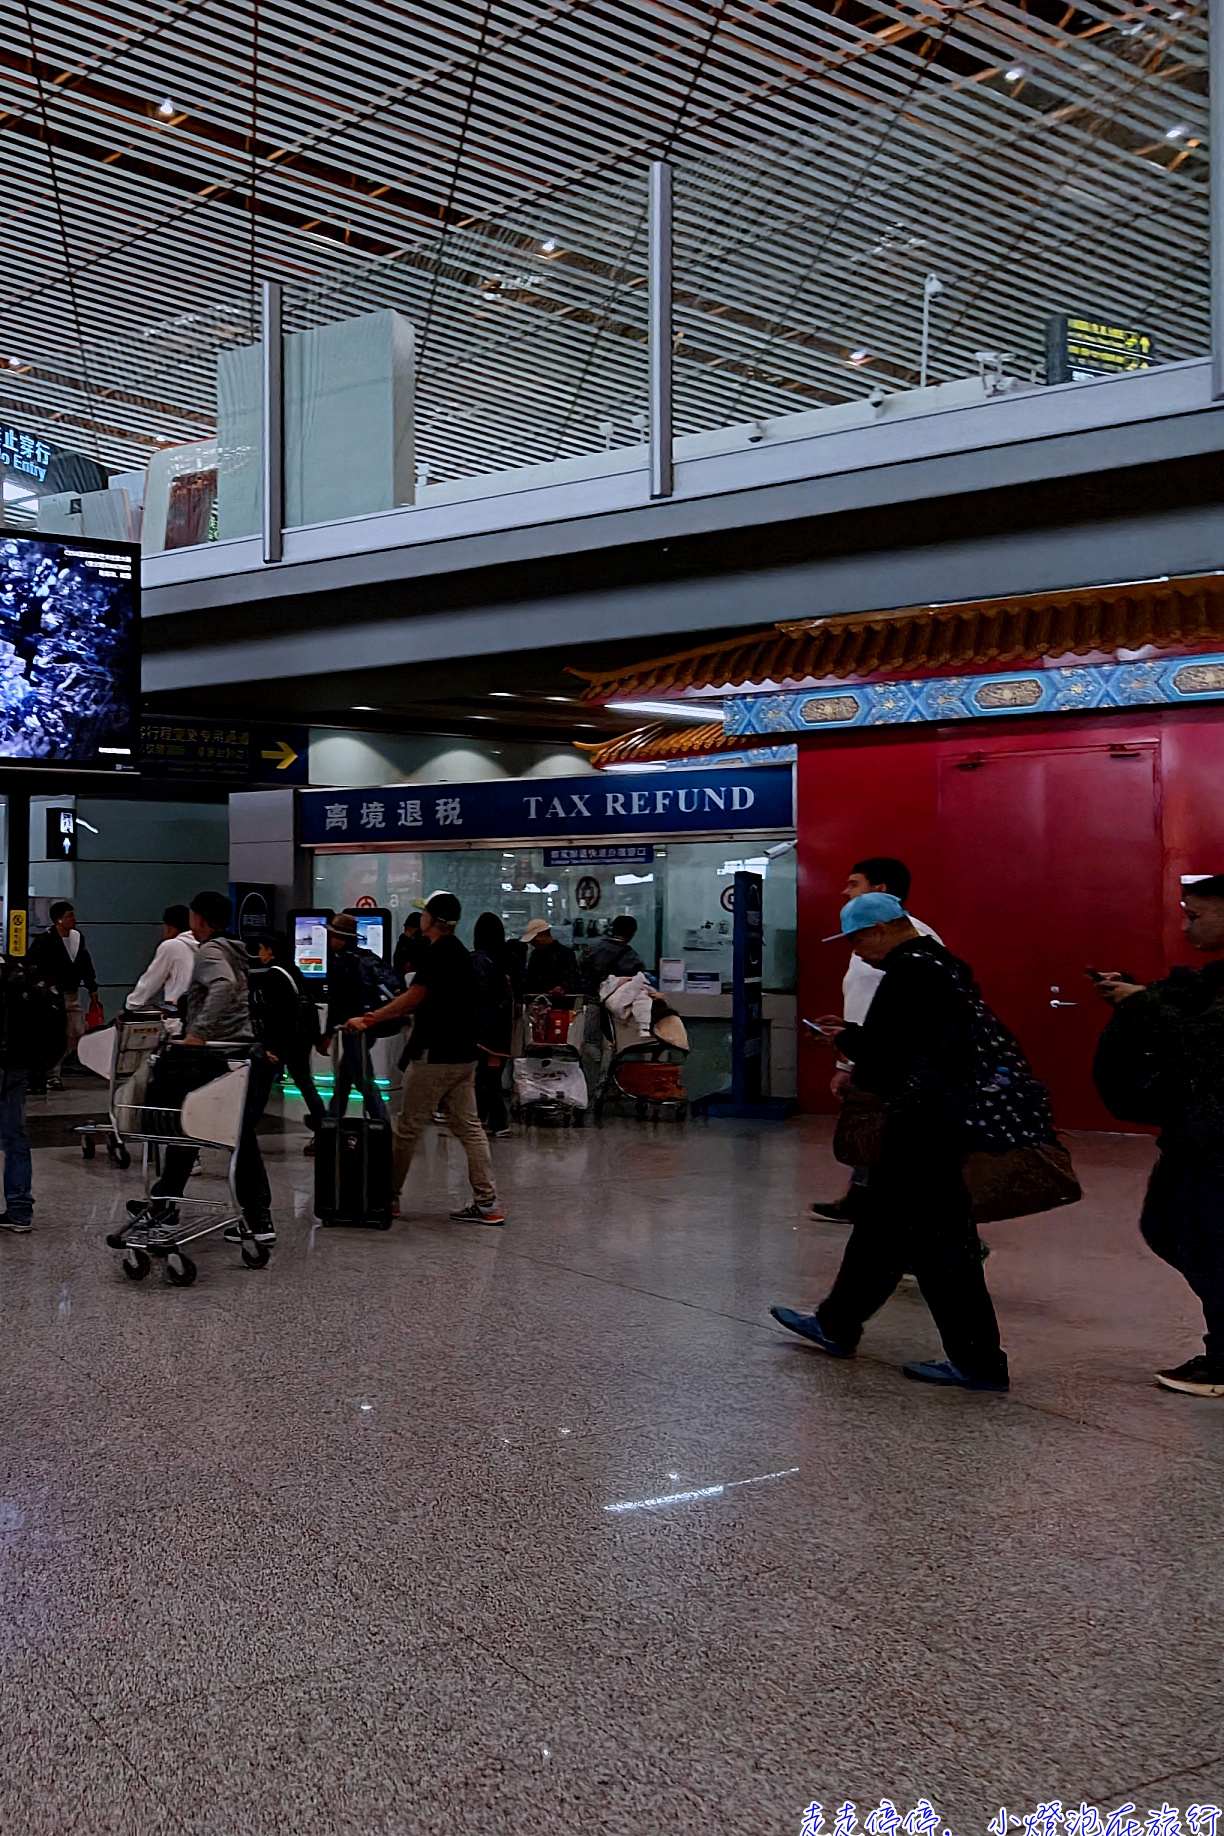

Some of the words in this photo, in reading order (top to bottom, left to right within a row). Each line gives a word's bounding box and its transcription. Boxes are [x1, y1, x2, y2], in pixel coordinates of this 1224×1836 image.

[13, 453, 47, 482] Entry
[323, 797, 464, 831] 离境退税
[523, 794, 592, 820] TAX
[605, 785, 755, 816] REFUND
